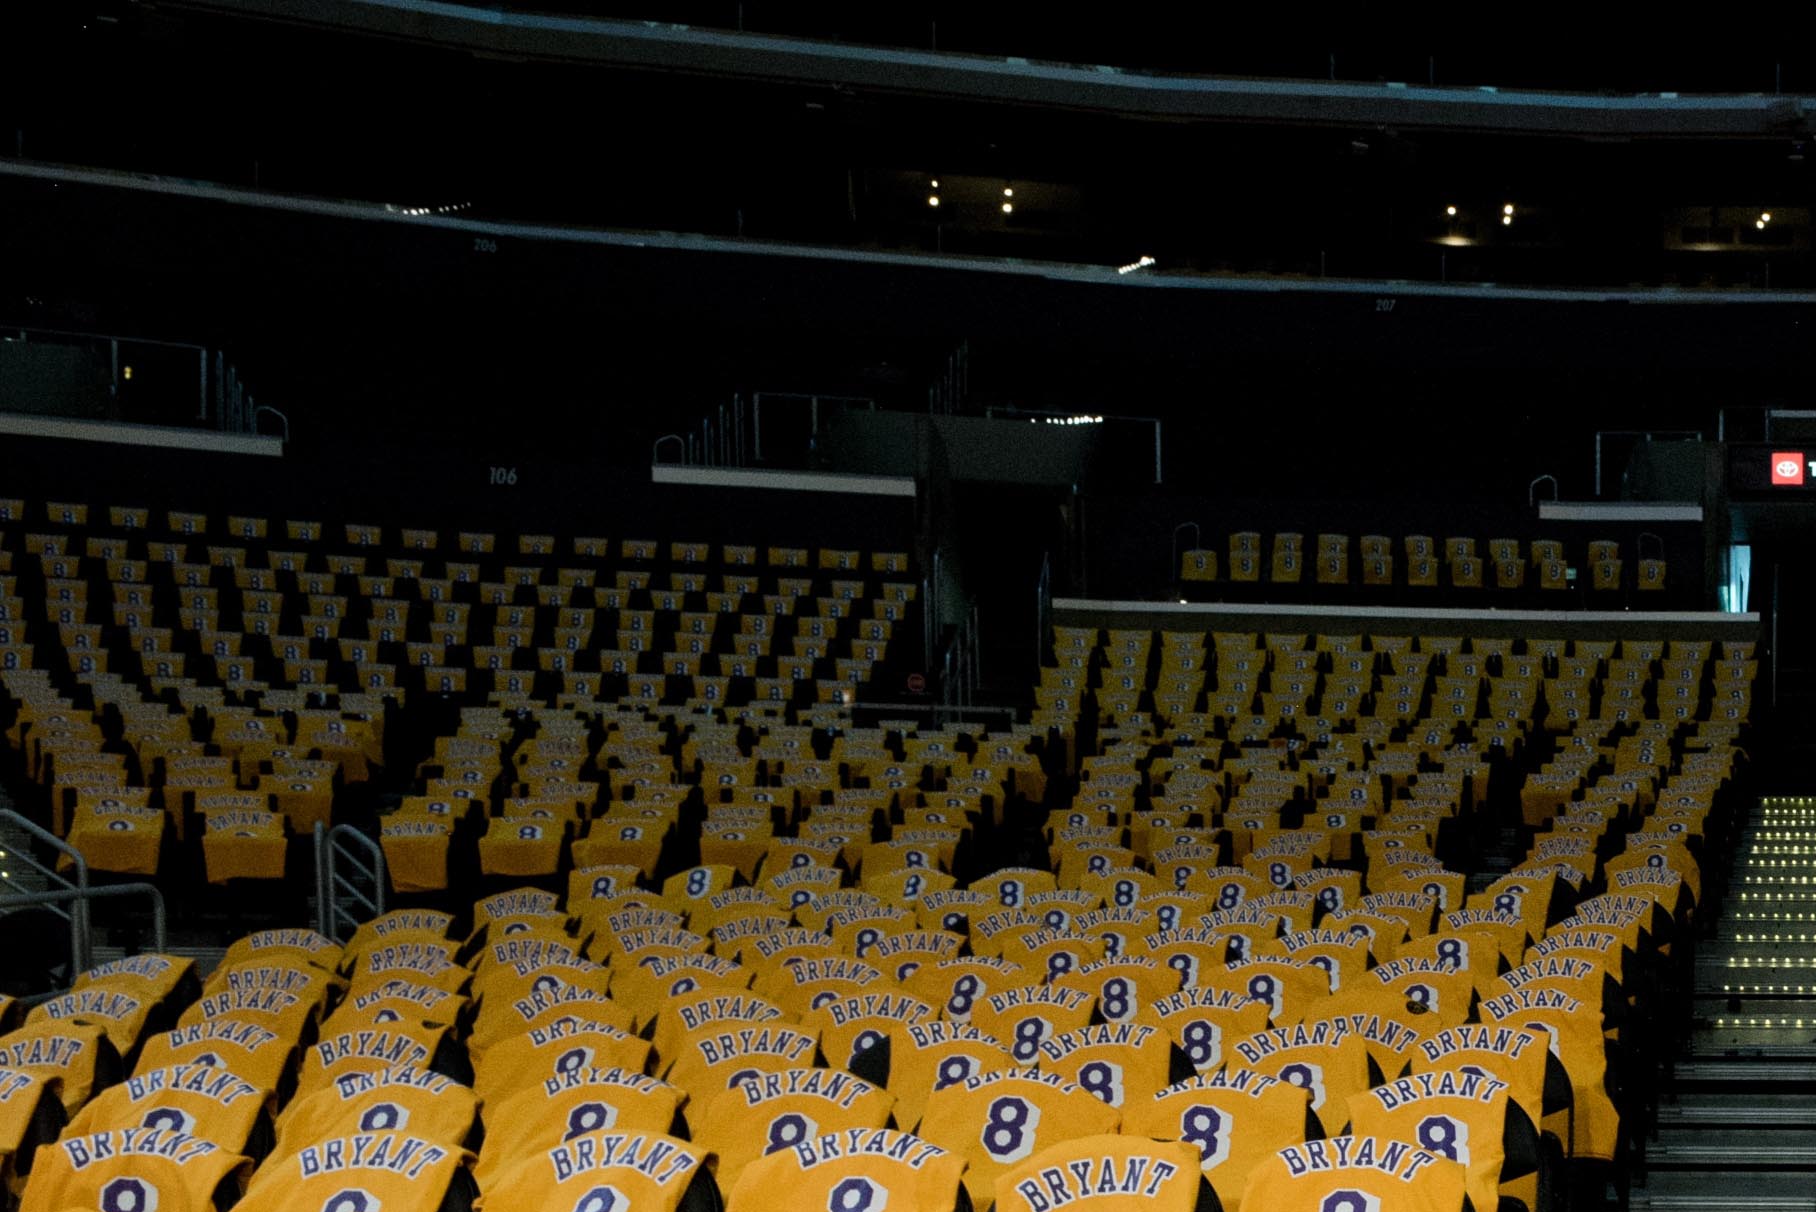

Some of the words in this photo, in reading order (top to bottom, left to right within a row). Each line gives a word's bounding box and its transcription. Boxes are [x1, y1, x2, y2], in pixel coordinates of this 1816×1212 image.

[1375, 298, 1397, 312] 207
[489, 466, 518, 485] 106
[687, 867, 712, 899] 8
[999, 880, 1025, 911] 8
[1113, 880, 1140, 909] 8
[1215, 883, 1247, 913] 8
[1075, 906, 1150, 933] BRYANT
[1145, 924, 1225, 950] BRYANT
[1199, 908, 1276, 933] BRYANT
[251, 926, 333, 951] BRYANT
[1433, 938, 1468, 974] 8
[1532, 932, 1615, 957] BRYANT
[648, 955, 740, 977] BRYANT
[791, 957, 880, 985] BRYANT
[1501, 958, 1593, 992] BRYANT
[43, 991, 139, 1020] BRYANT
[201, 984, 297, 1020] BRYANT
[680, 997, 780, 1029] BRYANT
[828, 995, 931, 1030] BRYANT
[947, 974, 986, 1022] 8
[988, 982, 1089, 1013] BRYANT
[1101, 977, 1137, 1028] 8
[1153, 984, 1257, 1018] BRYANT
[1484, 986, 1580, 1021] BRYANT
[168, 1021, 276, 1051] BRYANT
[316, 1031, 428, 1074] BRYANT
[698, 1029, 815, 1065] BRYANT
[1010, 1016, 1059, 1065] 8
[1035, 1019, 1156, 1063] BRYANT
[1181, 1020, 1221, 1071] 8
[1235, 1018, 1350, 1064] BRYANT
[1420, 1026, 1534, 1062] BRYANT
[123, 1068, 258, 1106] BRYANT
[335, 1060, 460, 1100] BRYANT
[544, 1065, 666, 1097] BRYANT
[739, 1068, 872, 1105] BRYANT
[1371, 1069, 1508, 1111] BRYANT
[62, 1123, 218, 1170] BRYANT
[792, 1120, 947, 1170] BRYANT
[981, 1096, 1040, 1164] 8
[1180, 1104, 1232, 1170] 8
[1409, 1114, 1470, 1174] 8
[298, 1130, 448, 1180] BRYANT
[548, 1126, 697, 1186] BRYANT
[1277, 1131, 1443, 1182] BRYANT
